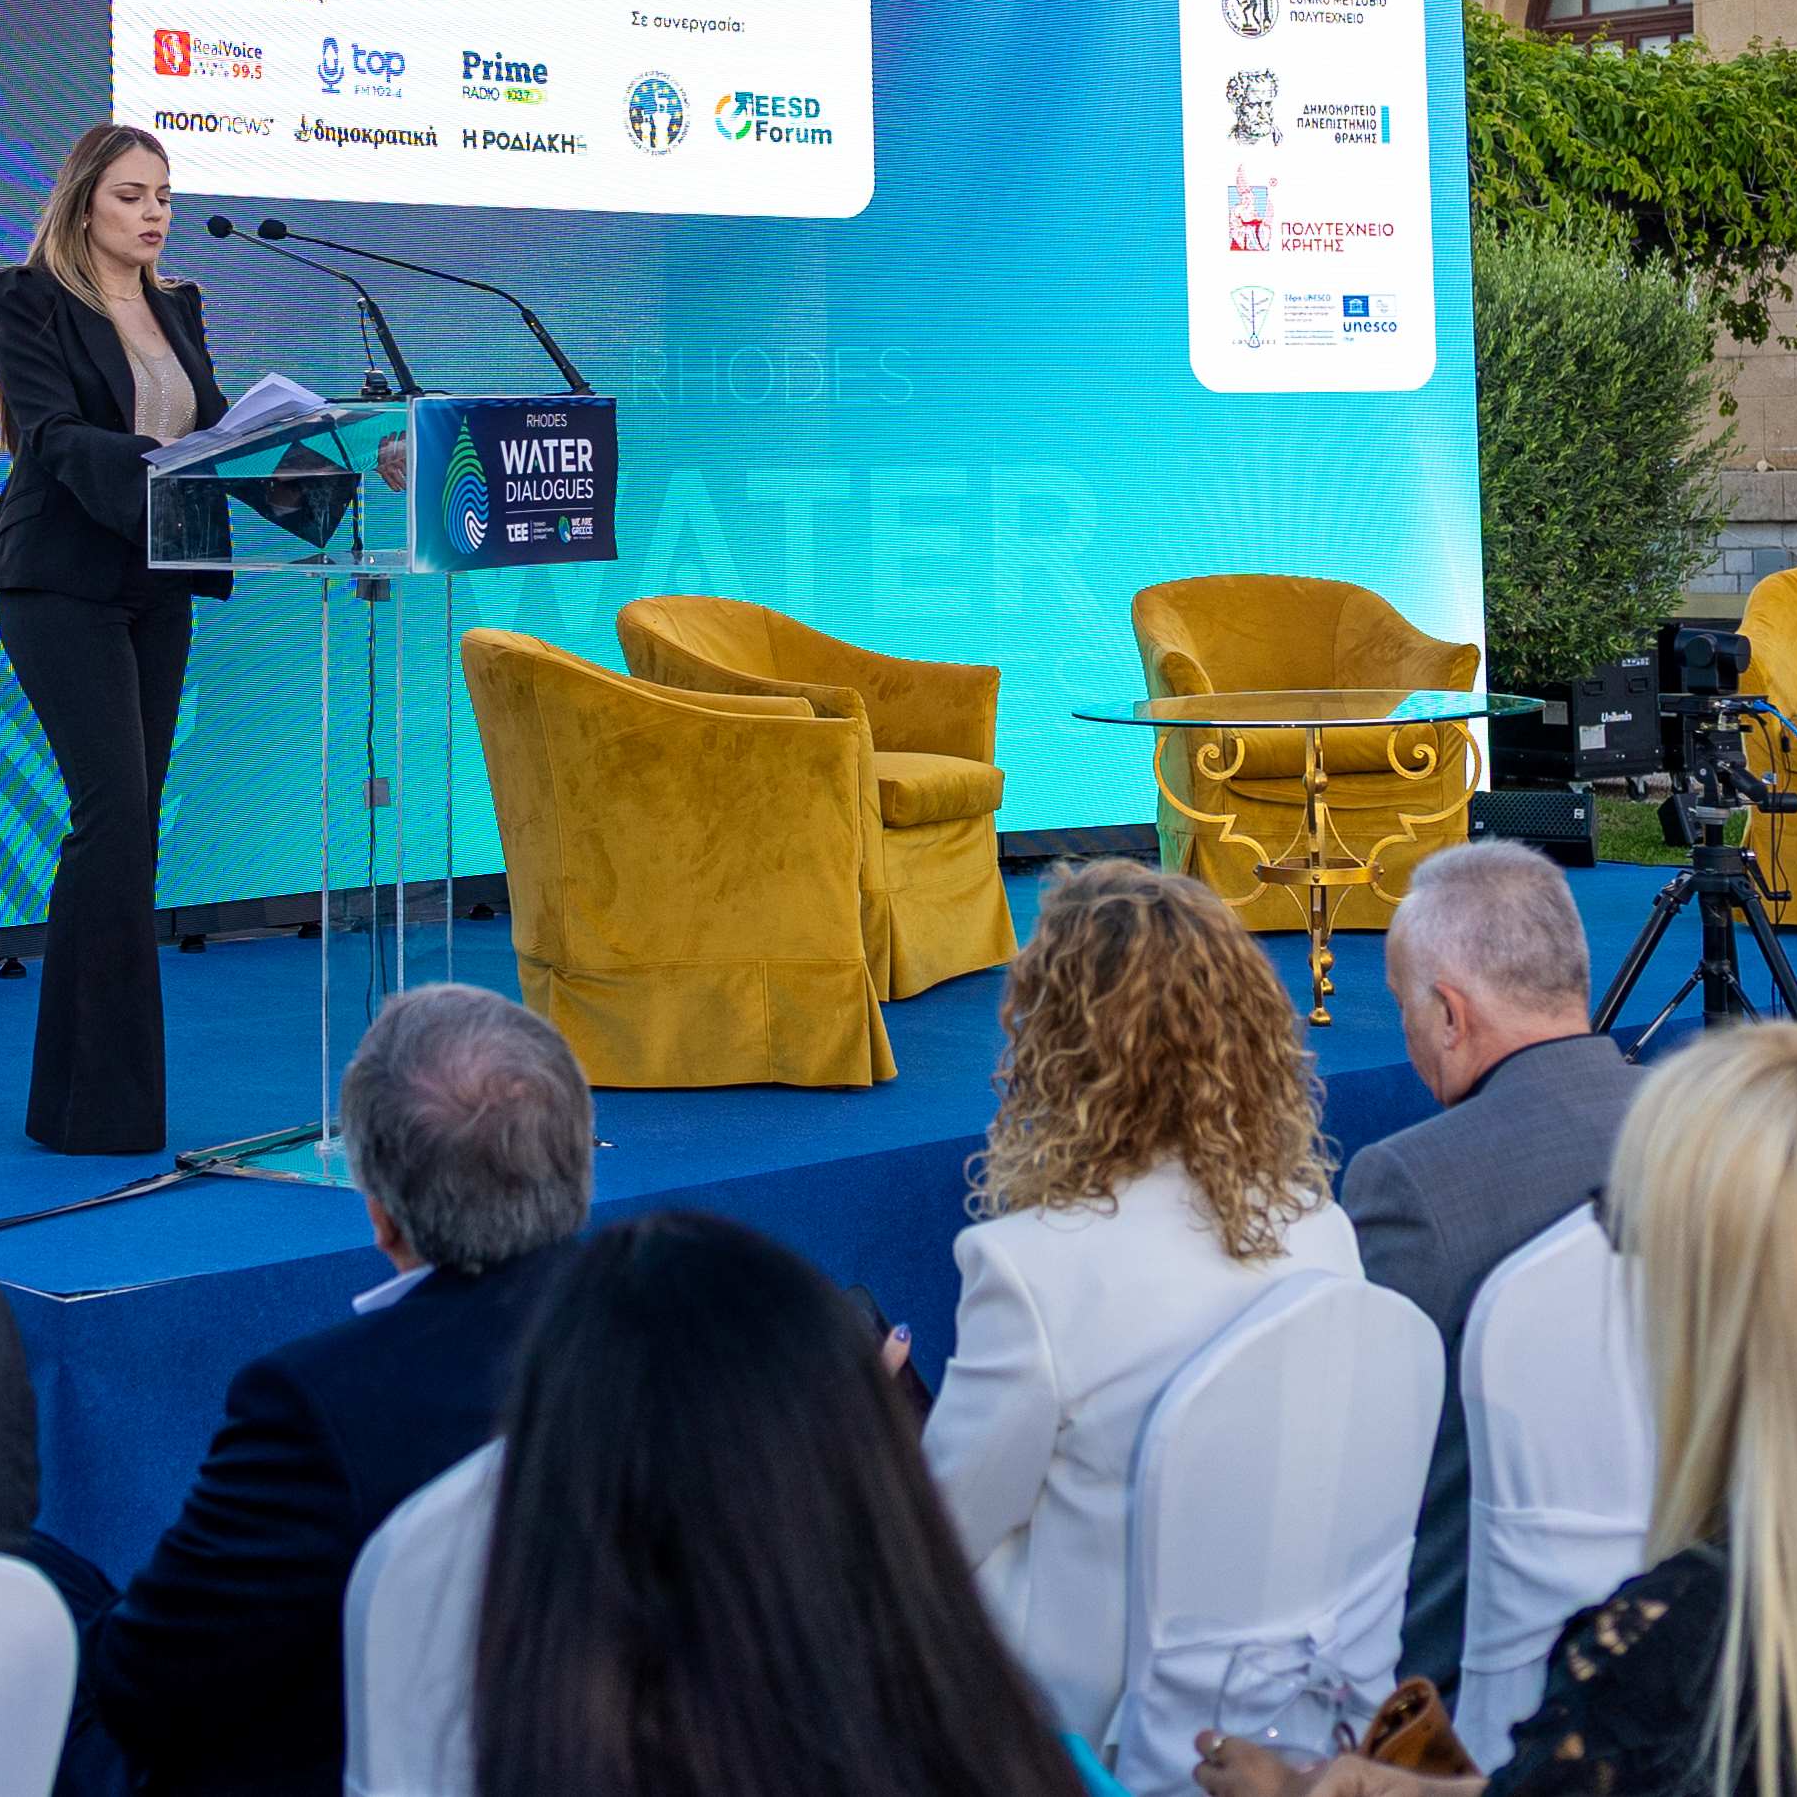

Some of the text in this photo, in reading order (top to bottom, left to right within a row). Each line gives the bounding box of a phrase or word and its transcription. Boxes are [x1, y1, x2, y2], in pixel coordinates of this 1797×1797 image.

[631, 10, 648, 27] Σε
[1289, 10, 1364, 24] ΠΟΛΥΤΕΧΝΕΙΟ
[193, 37, 263, 60] RealVoice
[232, 62, 263, 79] 99.5
[351, 42, 406, 83] top
[462, 50, 548, 85] Prime
[755, 95, 821, 118] EESD
[1303, 104, 1376, 116] ΔΗΜΟΚΡΙΤΕΙΟ
[755, 119, 833, 145] Forum
[1297, 117, 1377, 130] ΠΑΝΕΠΙΣΤΗΜΙΟ
[1334, 132, 1377, 144] ΘΡΑΚΗΣ
[1281, 222, 1394, 237] ΠΟΛΥΤΕΧΝΕΙΟ
[1281, 238, 1344, 253] ΚΡΗΤΗΣ
[1342, 321, 1398, 333] unesco
[630, 345, 916, 405] RHODES
[526, 413, 568, 428] RHODES
[500, 438, 593, 475] WATER
[506, 478, 594, 503] DIALOGUES
